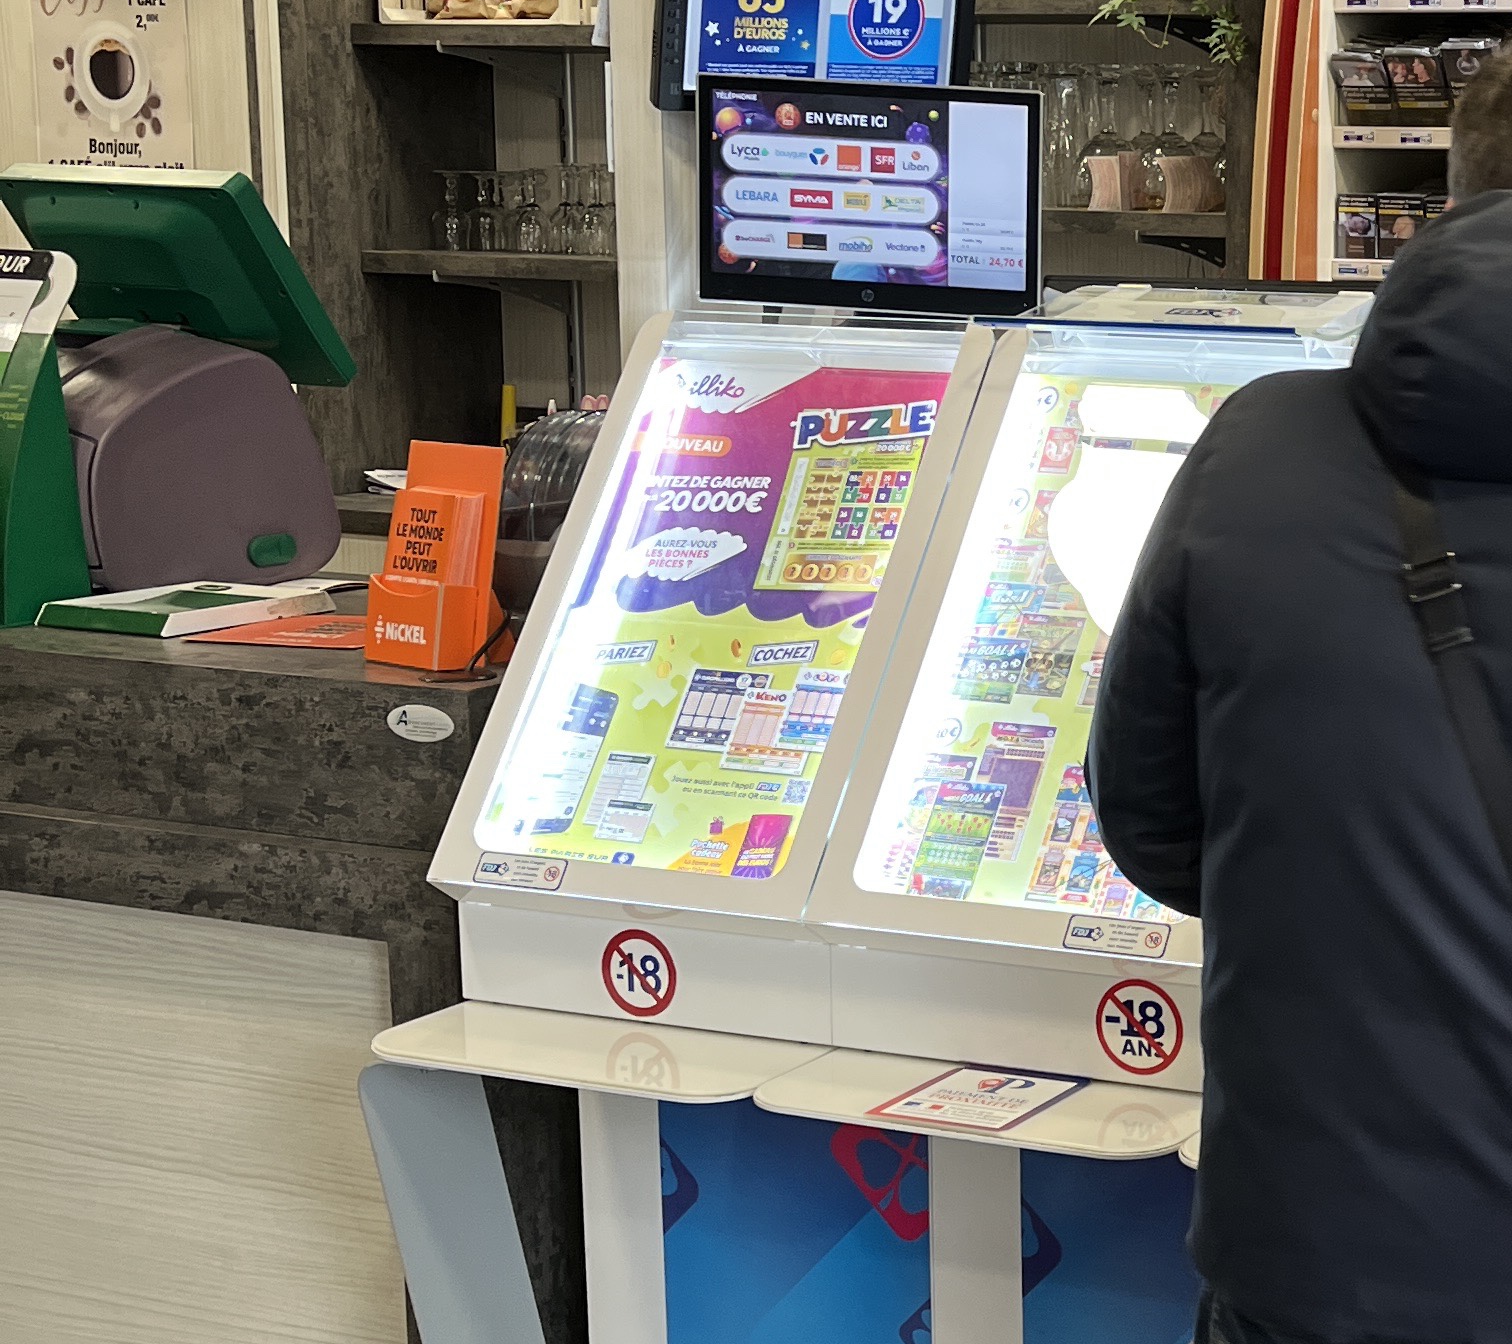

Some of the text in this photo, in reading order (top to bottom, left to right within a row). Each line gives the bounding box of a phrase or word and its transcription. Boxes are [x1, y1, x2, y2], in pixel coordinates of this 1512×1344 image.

[734, 17, 788, 28] MILLIONS
[737, 43, 779, 53] À GAGNER
[805, 111, 887, 128] EN VENTE ICI
[89, 138, 142, 158] Bonjour,
[731, 144, 760, 158] Lyca
[875, 154, 894, 166] SFR
[903, 161, 929, 172] Liban
[736, 190, 779, 202] LEBARA
[951, 255, 1024, 267] TOTAL 24,70 €
[689, 374, 745, 399] illiko
[799, 404, 934, 444] PUZZLE
[662, 436, 725, 453] OUVEAU
[690, 476, 708, 488] DE
[710, 476, 771, 490] GAGNER
[411, 507, 438, 523] TOUT
[397, 524, 444, 541] LE MONDE
[405, 540, 432, 556] PEUT
[654, 539, 718, 549] AUREZ-VOUS
[662, 548, 709, 558] BONNES
[393, 555, 438, 573] L'OUVRIR
[686, 560, 692, 568] ?
[597, 644, 649, 661] PARIEZ
[754, 646, 811, 662] COCHEZ
[755, 691, 787, 702] KENO
[617, 953, 661, 994] -18
[1105, 999, 1165, 1040] -18
